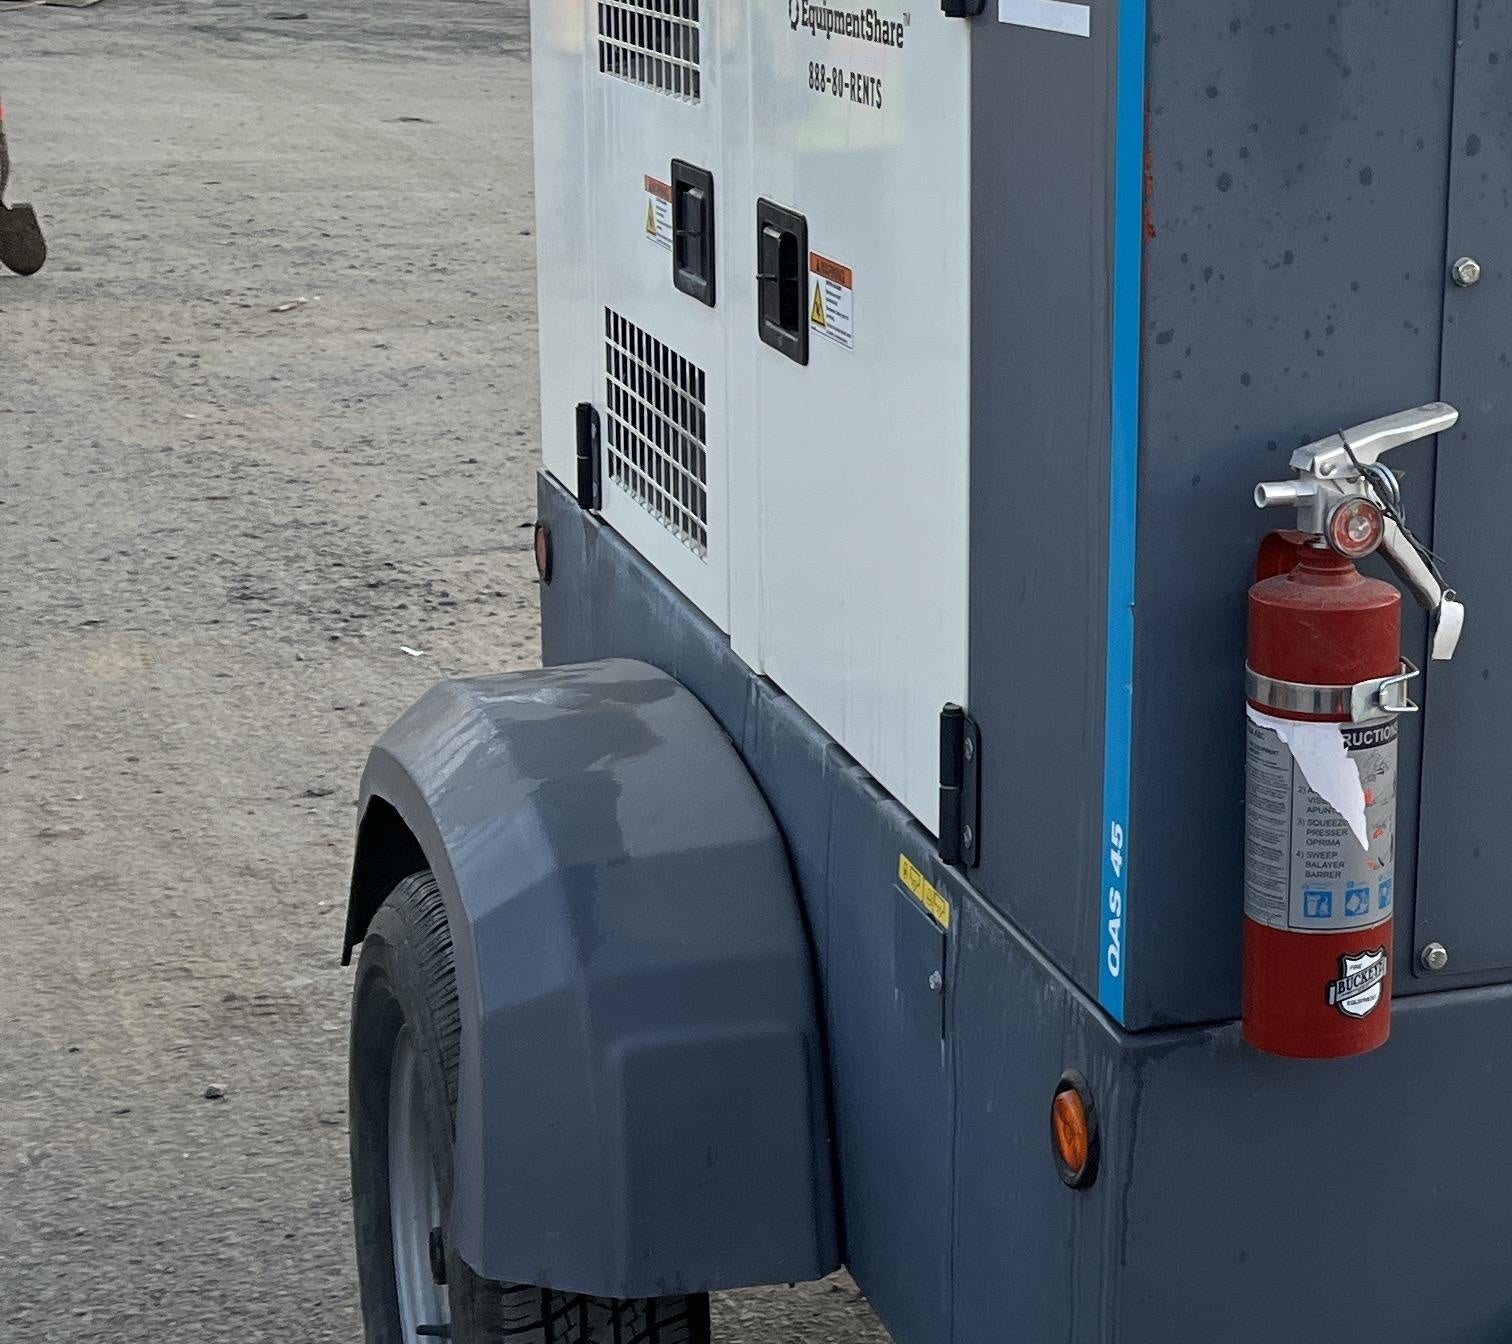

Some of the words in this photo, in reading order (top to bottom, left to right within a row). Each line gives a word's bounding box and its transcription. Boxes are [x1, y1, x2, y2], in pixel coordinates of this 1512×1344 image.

[808, 60, 882, 110] 888-80-RENTS
[1342, 721, 1398, 747] RUCTIONS
[1110, 821, 1123, 878] 45
[1306, 850, 1338, 860] SWEEP
[1304, 870, 1342, 879] BARRER
[1107, 886, 1122, 978] QAS
